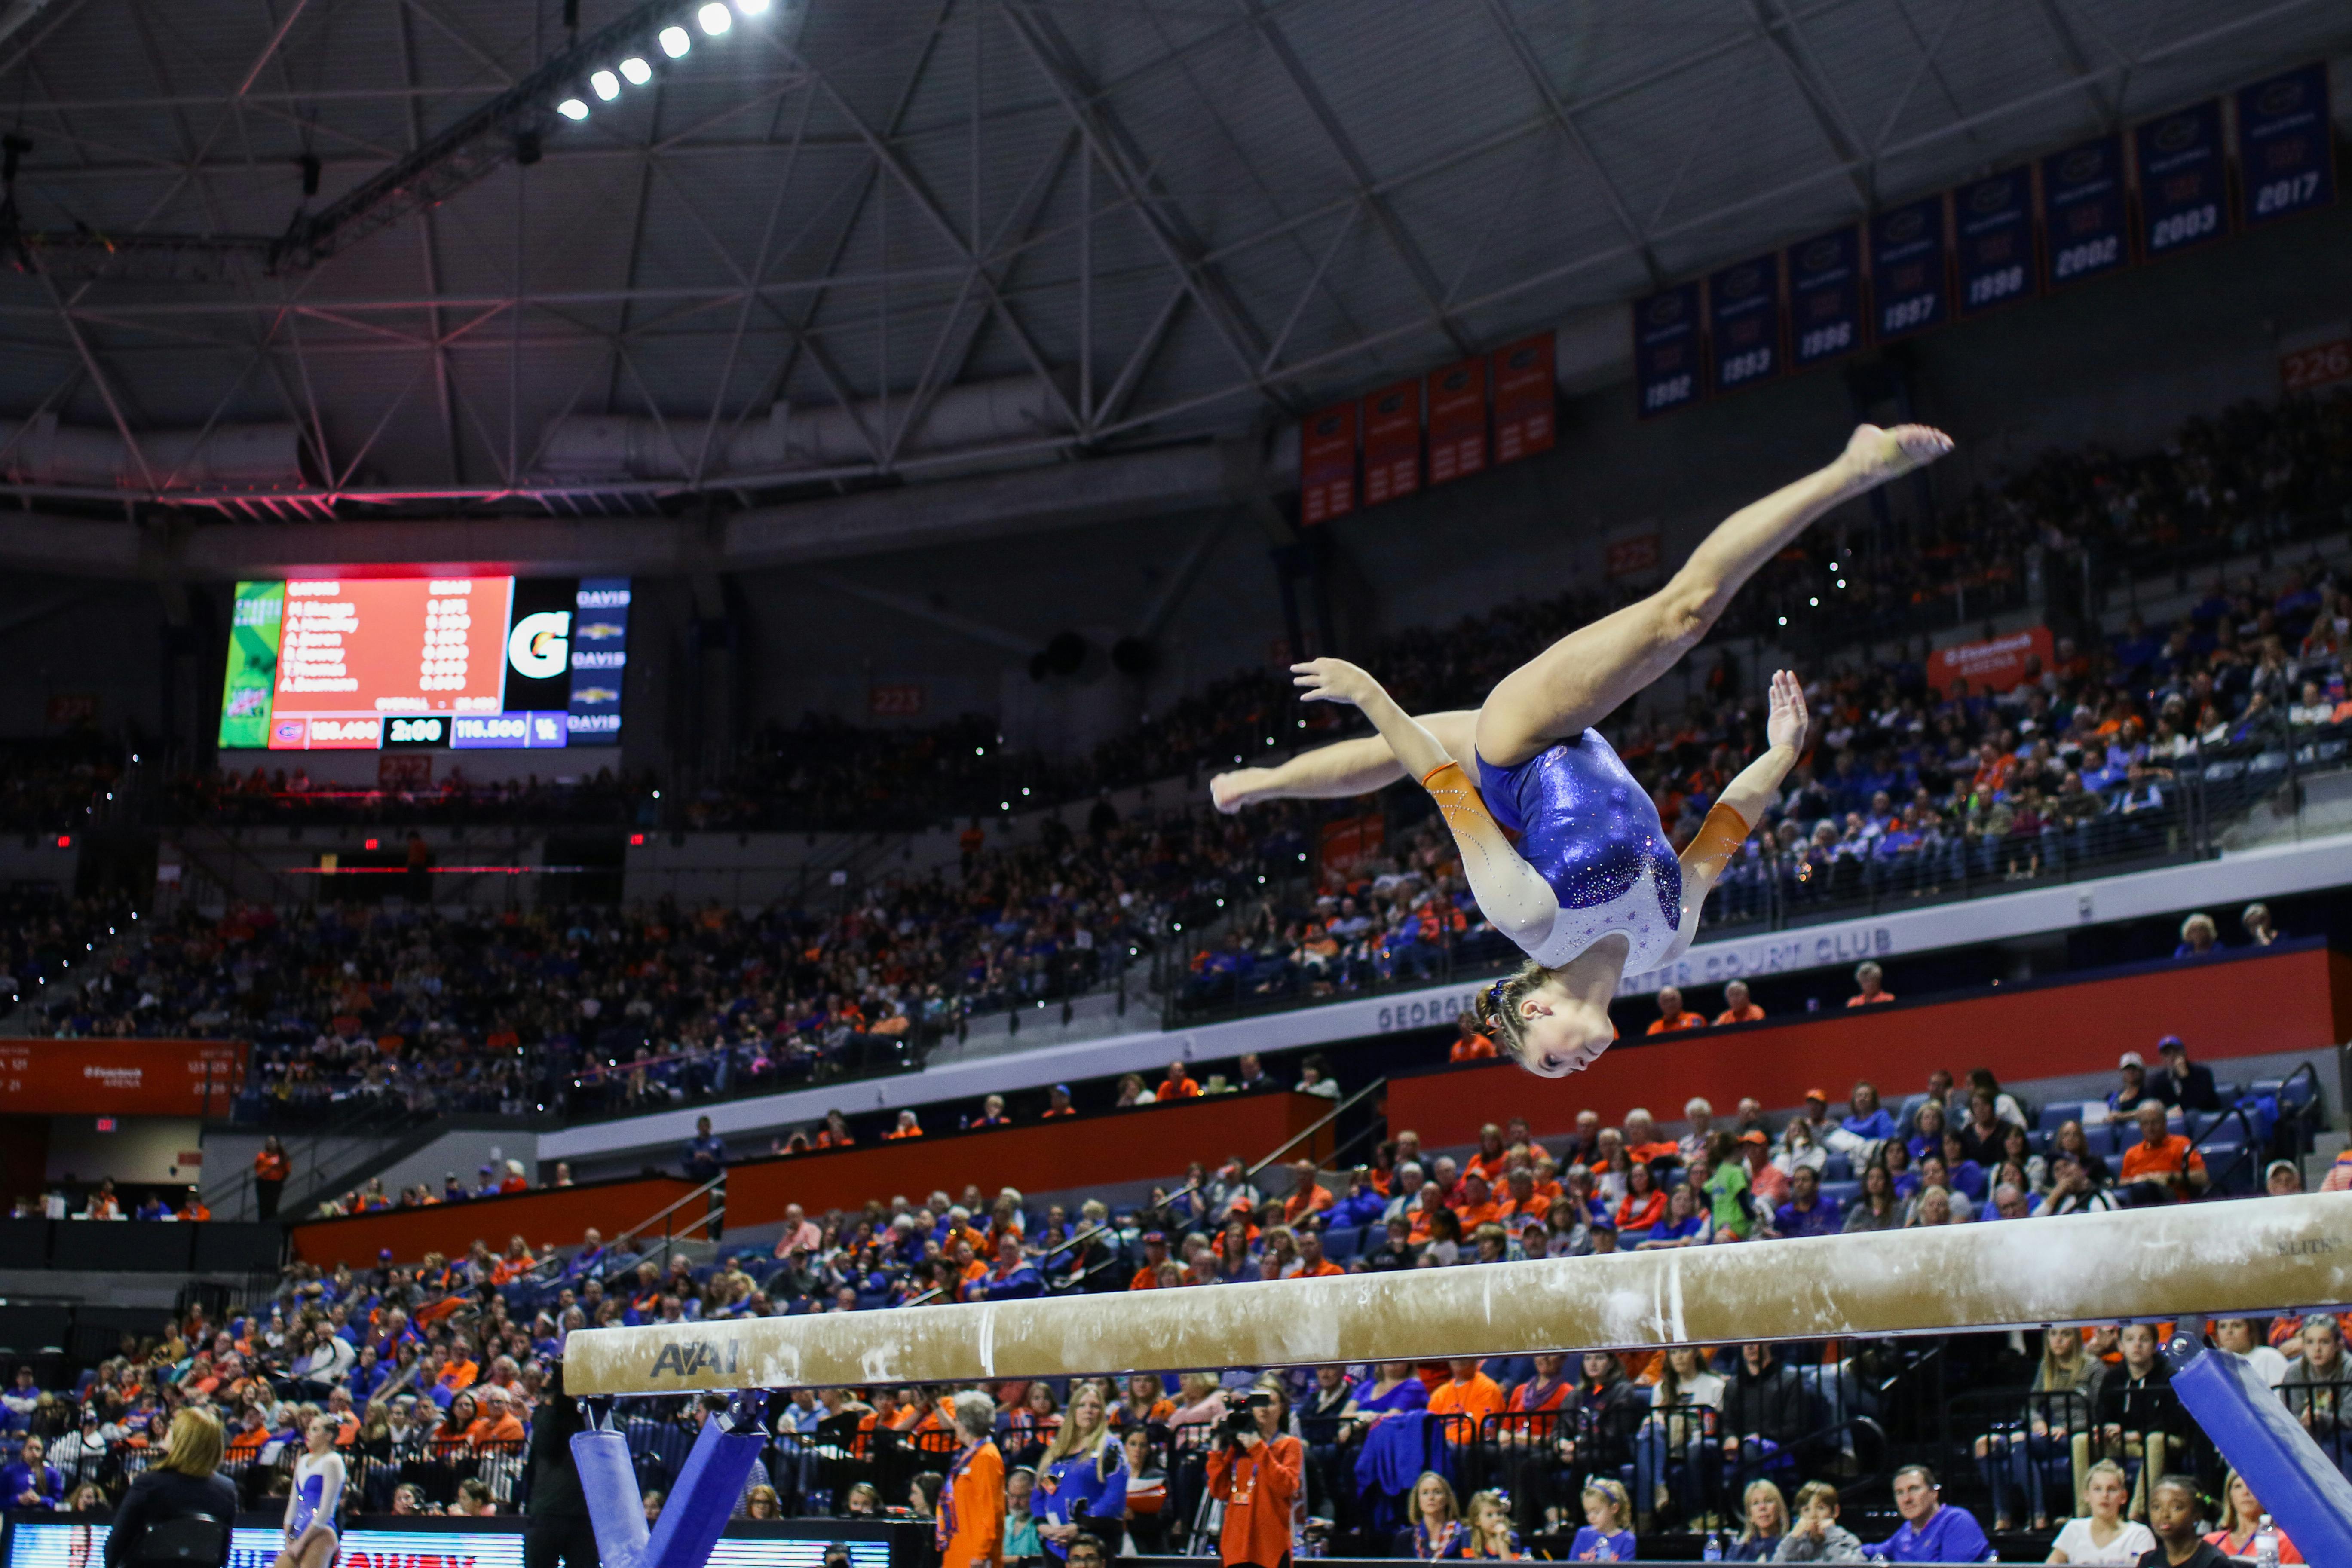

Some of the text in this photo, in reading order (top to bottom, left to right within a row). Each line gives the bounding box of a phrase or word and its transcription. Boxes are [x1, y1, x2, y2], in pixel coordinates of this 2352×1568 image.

[2256, 171, 2319, 213] 2017
[2152, 204, 2217, 249] 2003
[2056, 235, 2117, 278] 2002
[576, 590, 631, 608] DAVIS
[509, 611, 570, 679] G
[571, 652, 626, 669] DAVIS
[390, 719, 441, 741] 2:00
[567, 715, 621, 732] DAVIS
[1706, 944, 1800, 976] COURT
[1816, 928, 1890, 960] CLUB
